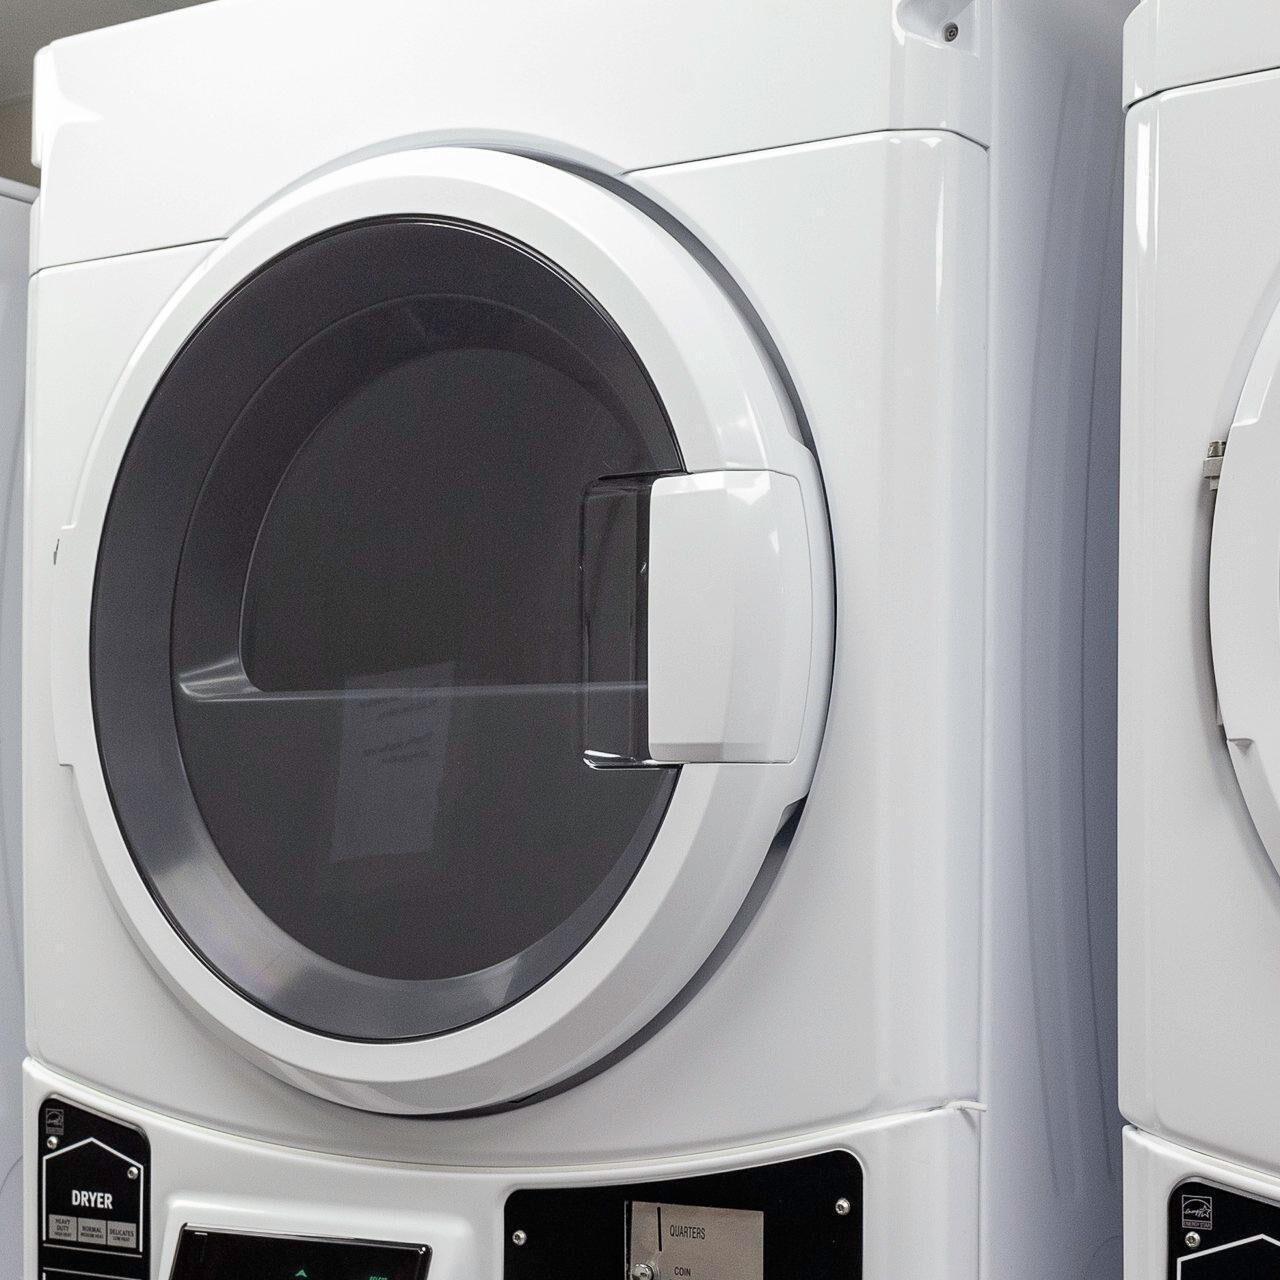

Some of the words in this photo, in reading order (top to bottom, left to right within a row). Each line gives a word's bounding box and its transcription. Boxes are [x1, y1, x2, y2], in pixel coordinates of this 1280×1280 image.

[71, 1189, 113, 1210] DRYER
[670, 1224, 706, 1240] QUARTERS
[674, 1266, 691, 1276] COIN
